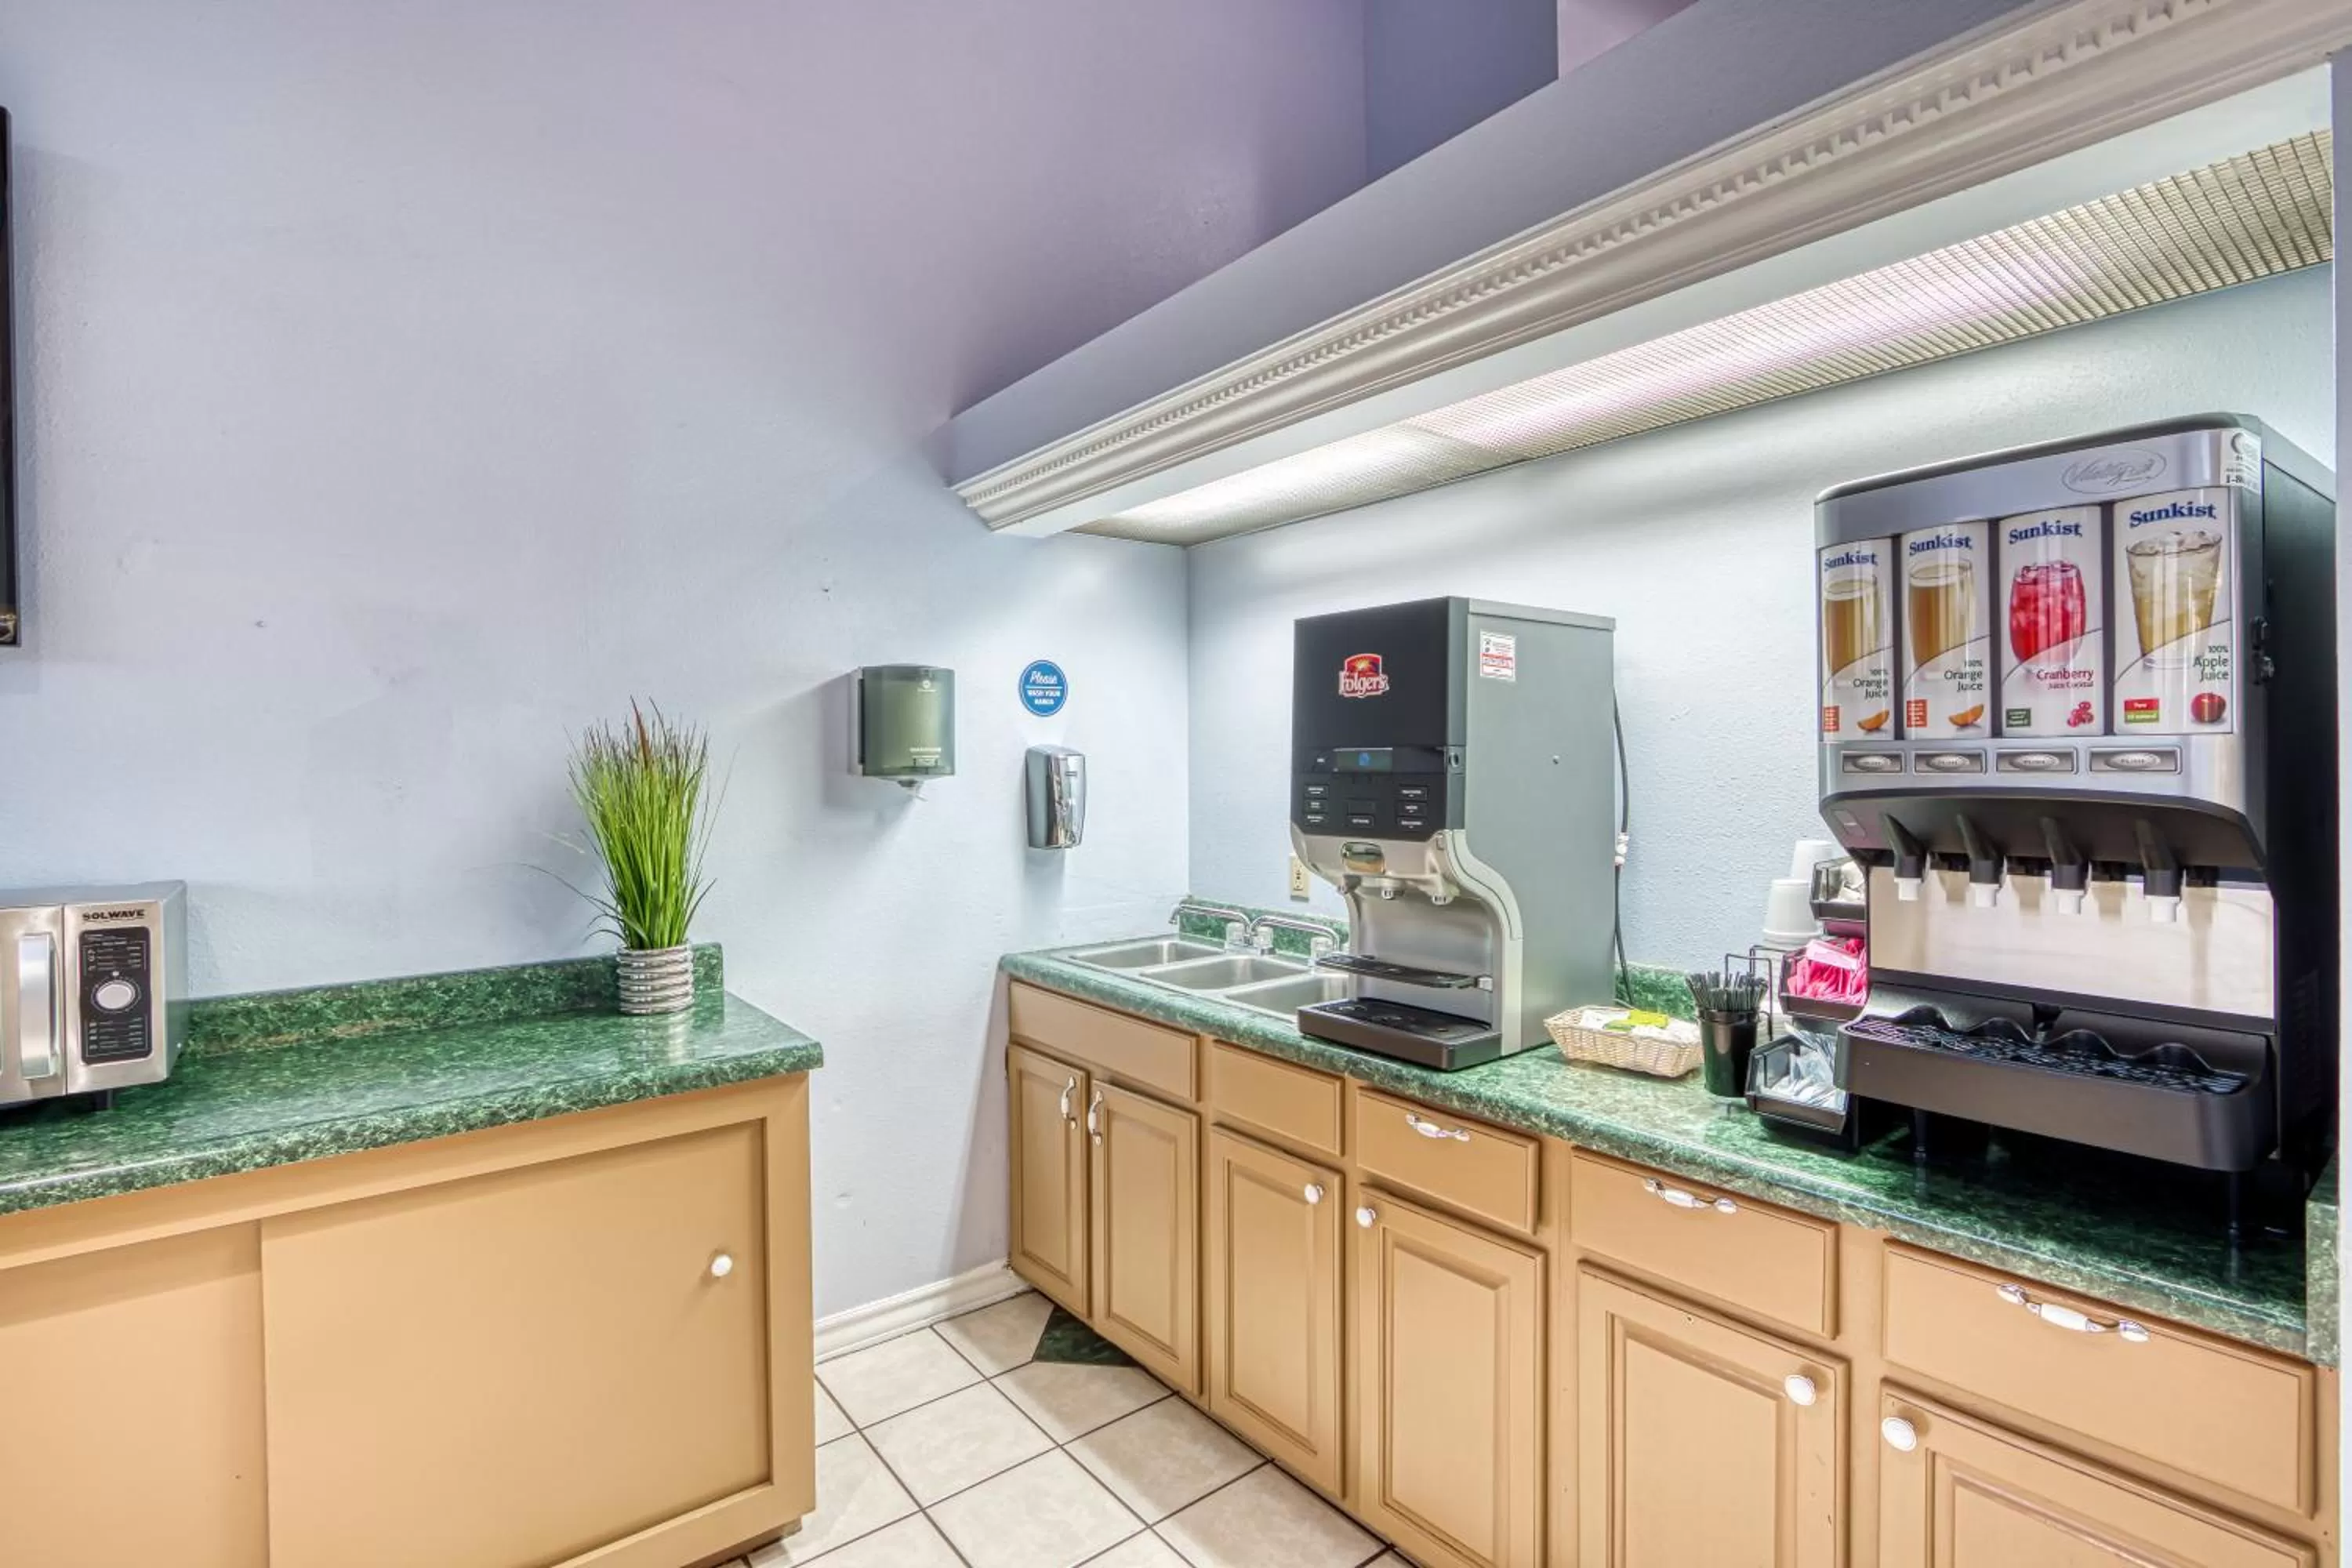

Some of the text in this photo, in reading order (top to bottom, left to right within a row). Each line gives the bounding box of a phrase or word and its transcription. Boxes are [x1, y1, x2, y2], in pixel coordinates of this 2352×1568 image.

[2129, 501, 2217, 528] Sunkist
[2009, 520, 2083, 545] Sunkist
[1909, 533, 1973, 557] Sunkist
[1824, 550, 1878, 572] Sunkist
[2192, 655, 2229, 671] Apple
[1944, 670, 1983, 682] Orange
[2036, 668, 2094, 681] Cranberry
[2199, 670, 2229, 683] Juice
[1338, 670, 1388, 697] Folgers
[1853, 678, 1889, 689] Orange
[1957, 681, 1984, 693] Juice
[1864, 688, 1889, 700] Juice
[82, 909, 145, 921] SOLWAVE
